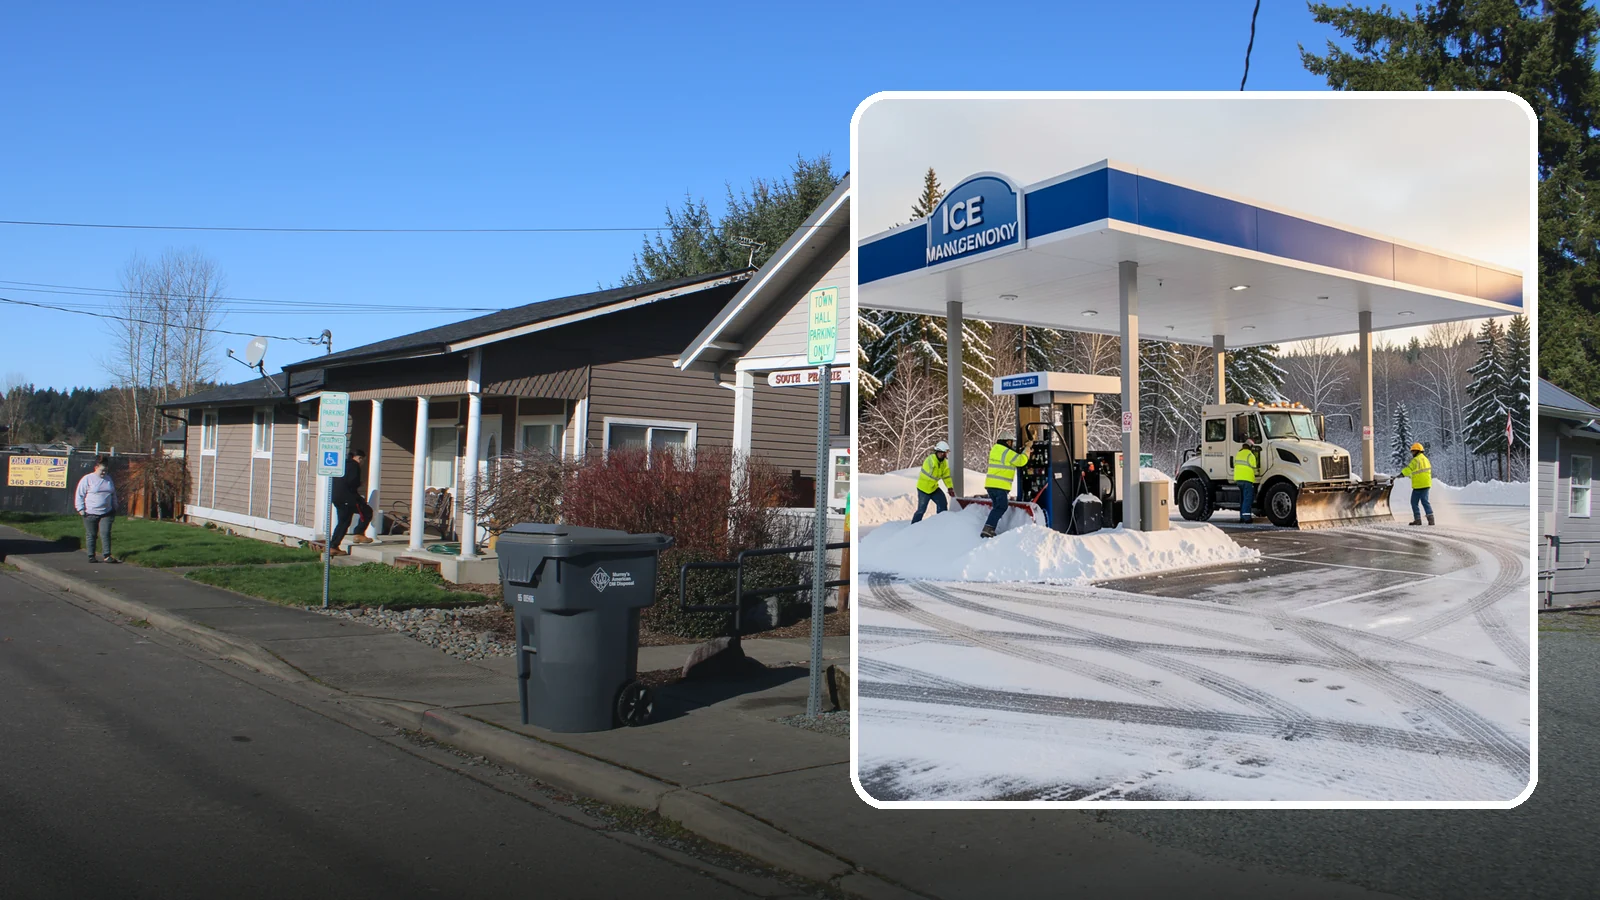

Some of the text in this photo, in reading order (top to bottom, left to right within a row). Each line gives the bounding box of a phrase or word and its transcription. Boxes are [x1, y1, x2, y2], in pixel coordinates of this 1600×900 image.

[943, 196, 983, 234] ICE
[815, 294, 833, 308] TOWN
[814, 311, 831, 324] HALL
[810, 327, 835, 341] PARKING
[813, 344, 831, 357] ONLY
[775, 373, 801, 385] SOUTH
